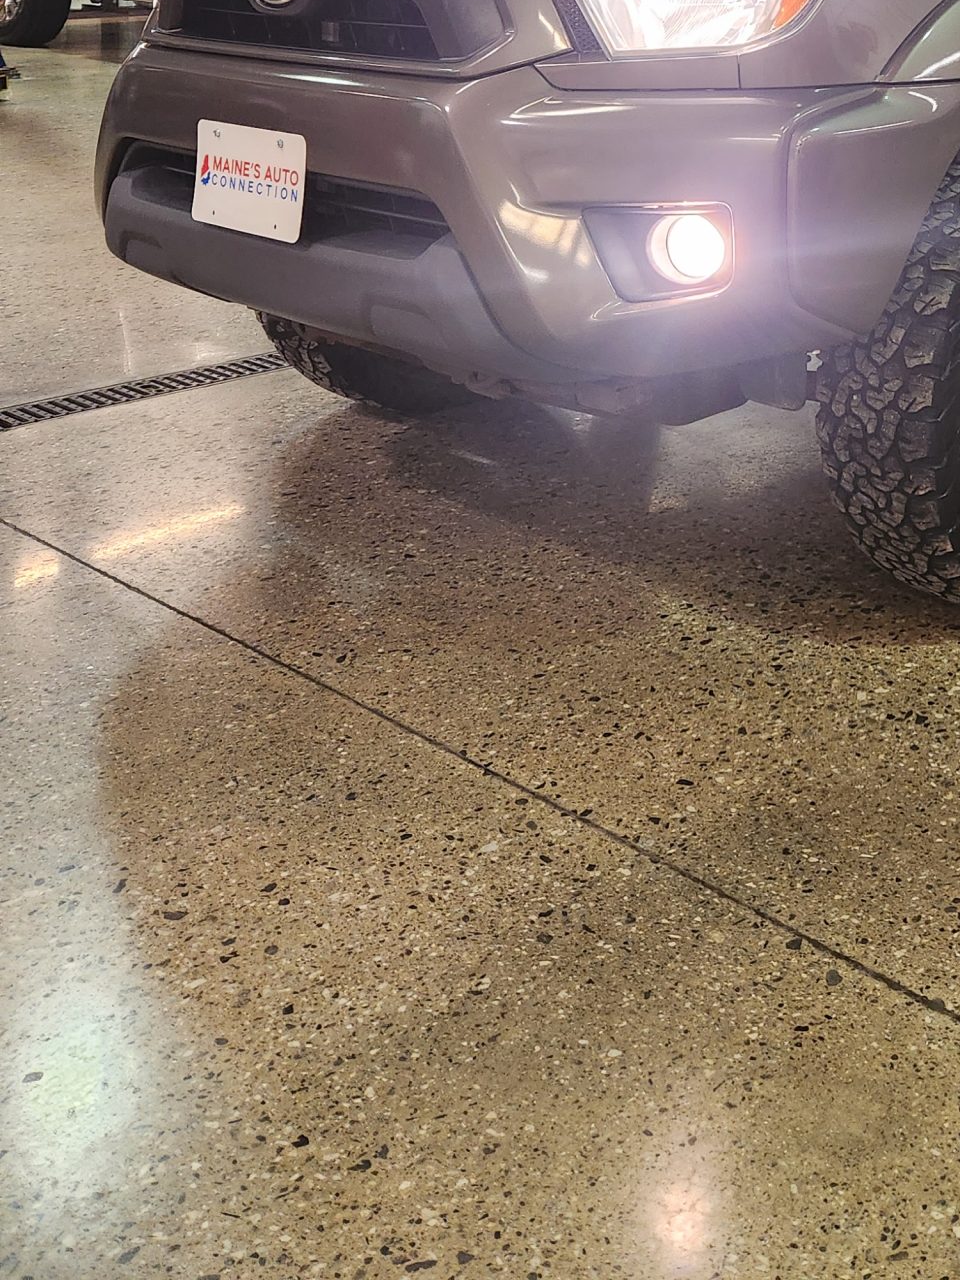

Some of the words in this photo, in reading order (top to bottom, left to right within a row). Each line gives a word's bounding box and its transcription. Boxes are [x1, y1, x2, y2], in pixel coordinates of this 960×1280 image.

[212, 155, 261, 179] MAINE'S
[264, 165, 299, 186] AUTO
[211, 173, 298, 202] CONNECTION
